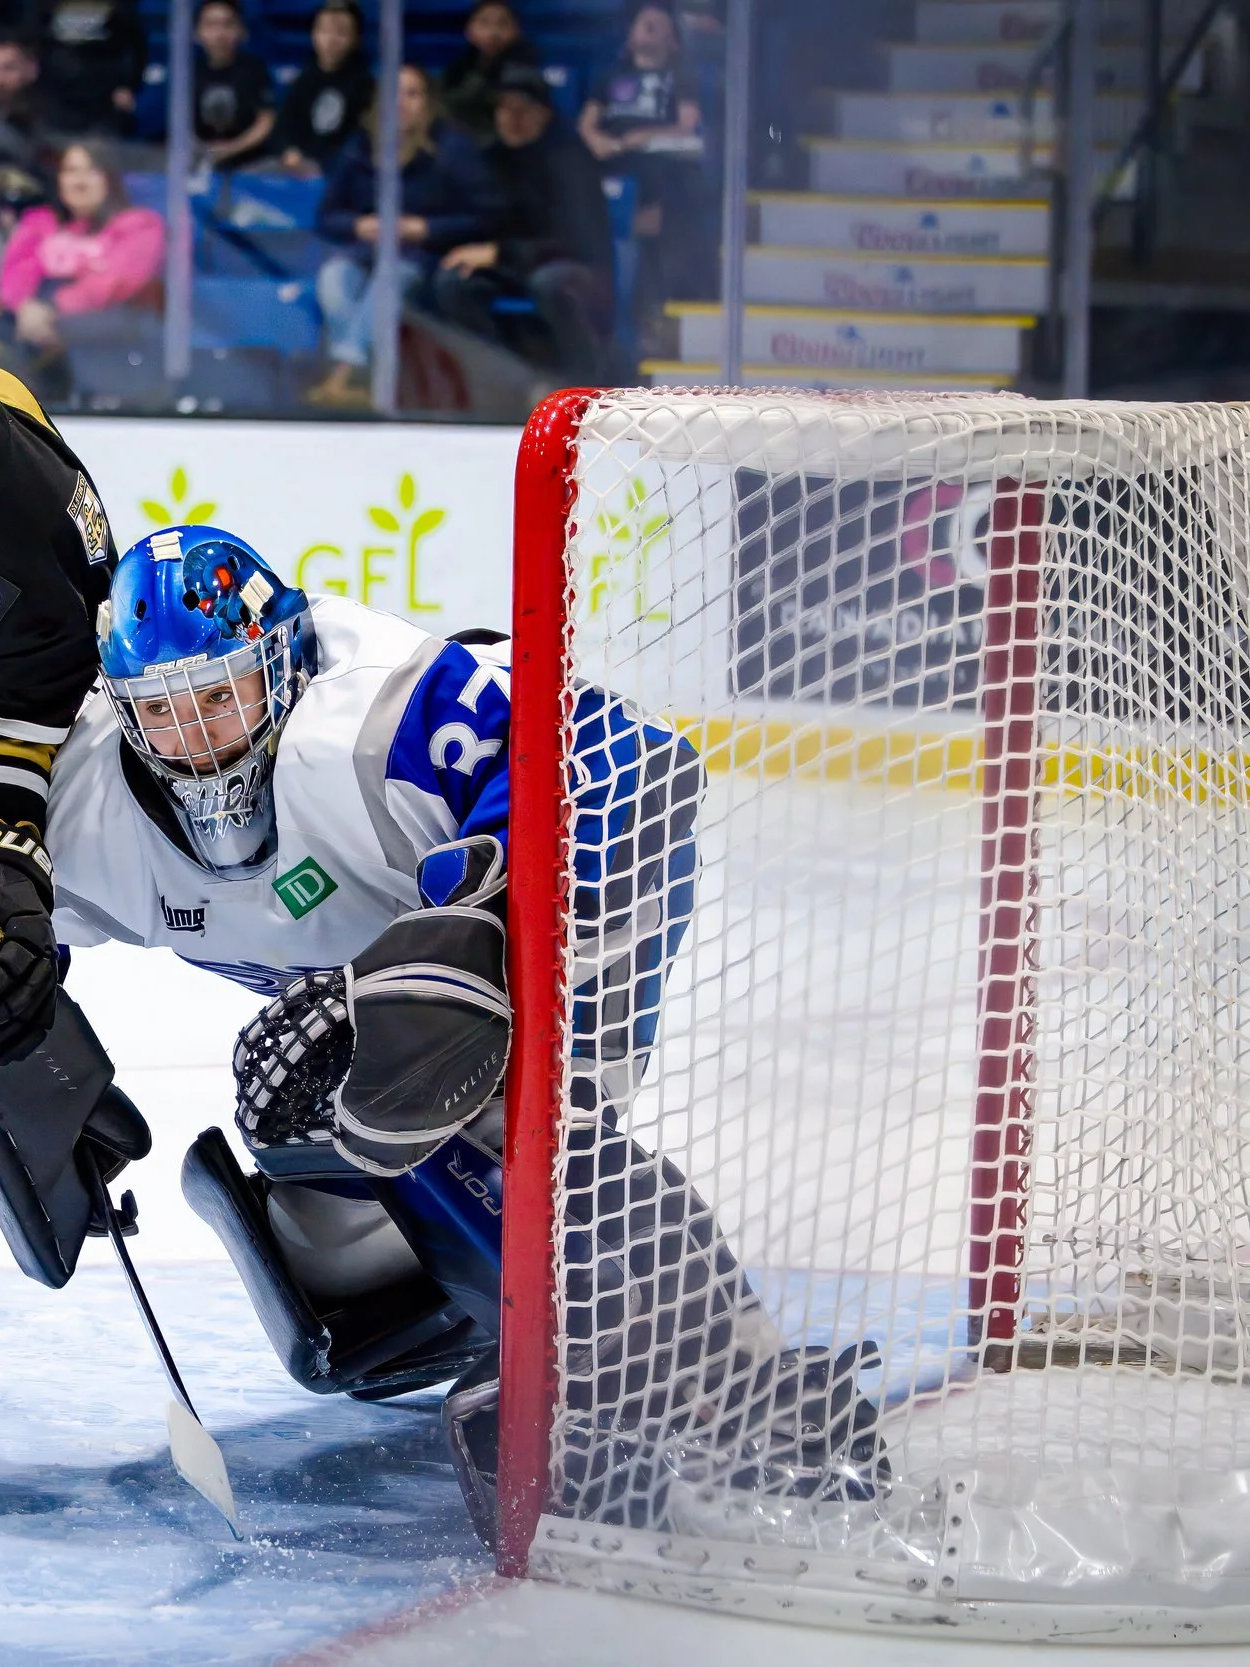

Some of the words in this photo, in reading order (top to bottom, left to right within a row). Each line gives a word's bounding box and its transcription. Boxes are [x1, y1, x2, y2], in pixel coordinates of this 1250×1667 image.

[296, 510, 445, 610] GFL
[277, 867, 326, 909] TD
[444, 1051, 499, 1113] FLYLITE
[446, 1149, 503, 1217] POR
